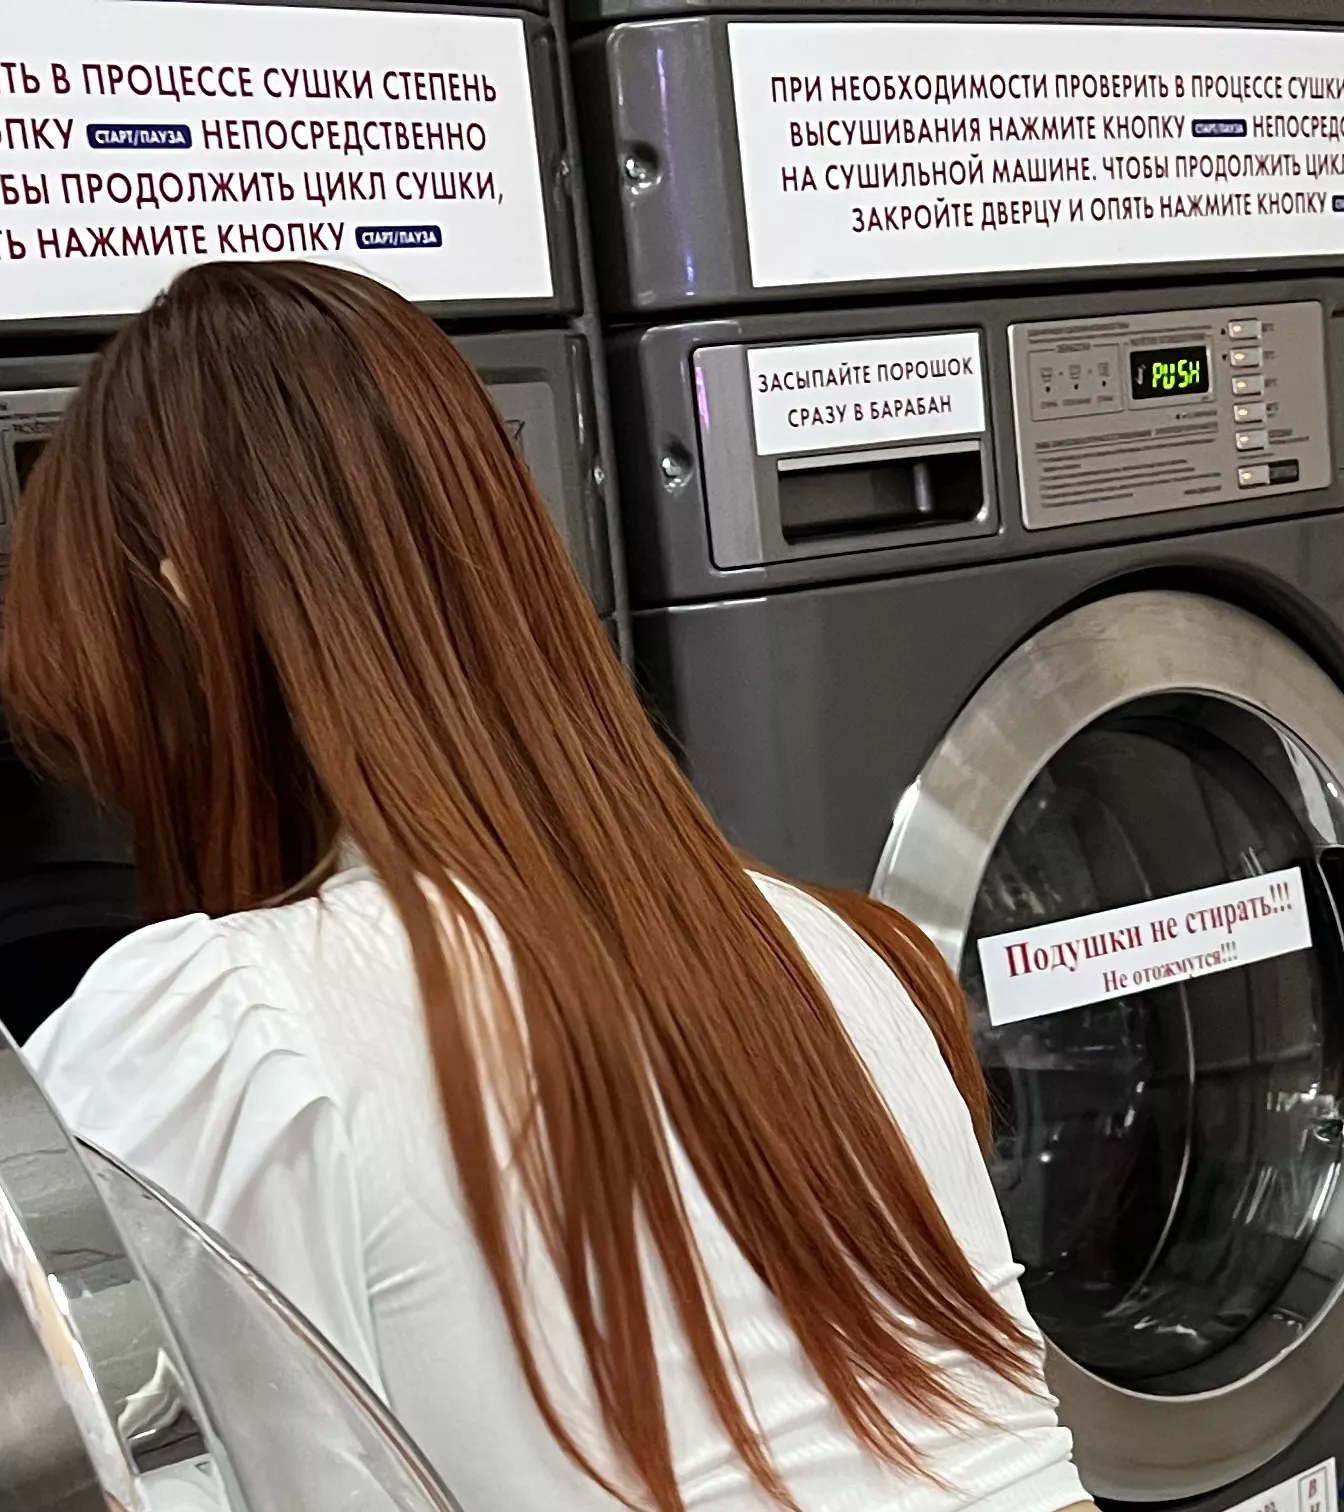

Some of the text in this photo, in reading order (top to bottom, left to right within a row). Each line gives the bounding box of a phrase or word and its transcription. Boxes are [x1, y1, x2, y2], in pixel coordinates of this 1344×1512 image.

[50, 62, 71, 95] В
[81, 63, 254, 103] ПРОЦЕССЕ
[263, 67, 374, 100] СУШКИ
[382, 70, 497, 102] СТЕПЕНЬ
[771, 75, 823, 103] ПРИ
[830, 73, 1048, 105] НЕОБХОДИМОСТИ
[1055, 73, 1169, 99] ПРОВЕРИТЬ
[1174, 74, 1185, 98] В
[1191, 74, 1283, 103] ПРОЦЕССЕ
[94, 129, 187, 146] СТАРТ/ПАУЗА
[201, 119, 486, 156] НЕПОСРЕДСТВЕННО
[789, 117, 981, 148] ВЫСУШИВАНИЯ
[988, 115, 1097, 142] НАЖМИТЕ
[1102, 114, 1186, 140] КНОПКУ
[60, 171, 295, 210] ПРОДОЛЖИТЬ
[303, 171, 387, 208] ЦИКЛ
[395, 171, 504, 206] СУШКИ,
[781, 165, 818, 192] НА
[825, 153, 984, 191] СУШИЛЬНОЙ
[992, 157, 1097, 184] МАШИНЕ.
[1102, 155, 1169, 180] ЧТОБЫ
[1175, 153, 1301, 182] ПРОДОЛЖИТЬ
[851, 196, 974, 233] ЗАКРОЙТЕ
[980, 198, 1062, 232] ДВЕРЦУ
[1068, 198, 1084, 223] И
[1090, 196, 1154, 222] ОПЯТЬ
[1159, 192, 1252, 219] НАЖМИТЕ
[1256, 191, 1327, 215] КНОПКУ
[36, 224, 208, 259] НАЖМИТЕ
[217, 221, 345, 254] КНОПКУ
[757, 356, 974, 394] ЗАСЫПАЙТЕ ПОРОШОК
[1151, 358, 1201, 391] PUSH
[787, 394, 952, 428] СРАЗУ В БАРАБАН
[1004, 881, 1293, 979] Подушки не стирать!!!
[1102, 969, 1129, 993] Не
